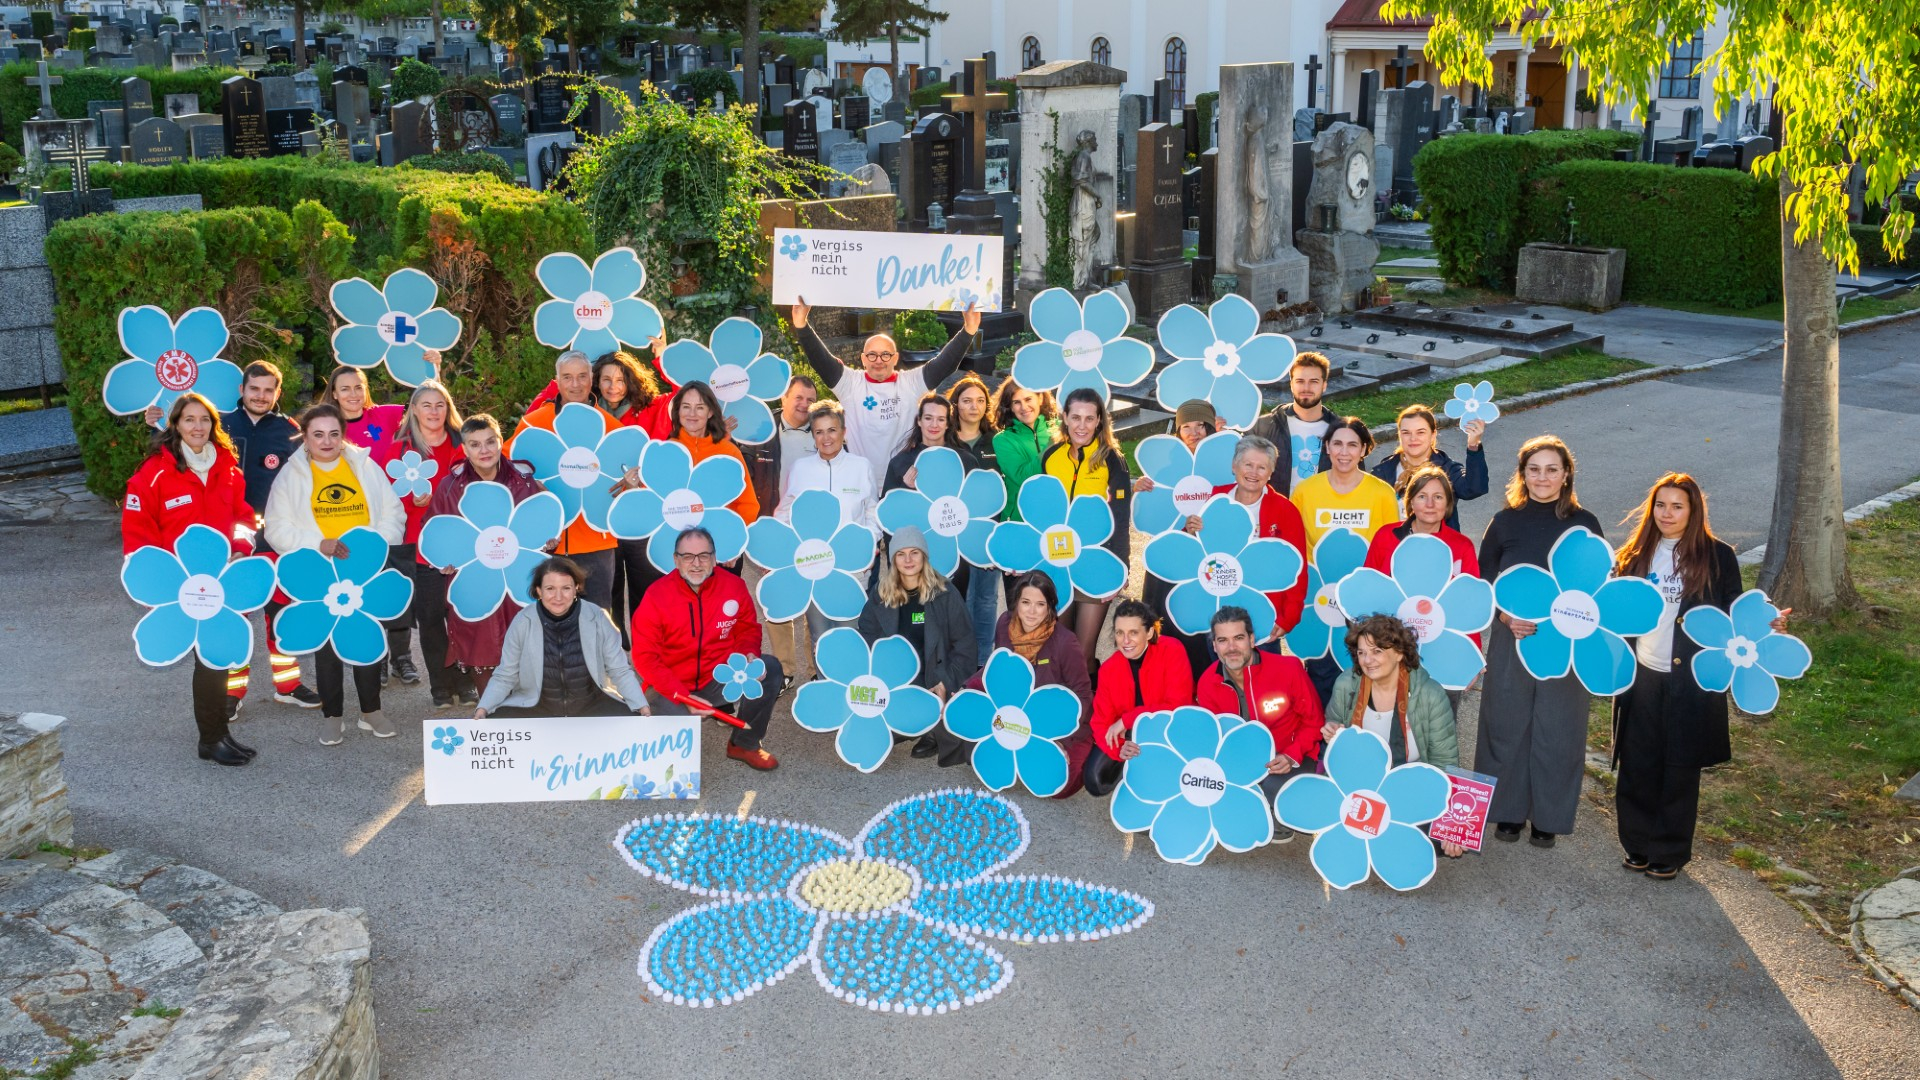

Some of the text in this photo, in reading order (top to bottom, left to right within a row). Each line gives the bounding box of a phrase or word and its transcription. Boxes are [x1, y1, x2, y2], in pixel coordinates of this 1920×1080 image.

[811, 239, 863, 253] Vergiss
[812, 253, 842, 264] mein
[811, 264, 848, 276] nicht
[876, 243, 983, 299] Danke!
[576, 304, 602, 317] cbm
[1332, 512, 1364, 520] LICHT
[1217, 579, 1238, 587] NETZ
[1662, 585, 1681, 594] mei
[470, 729, 532, 744] Vergiss
[471, 745, 507, 756] mein
[471, 757, 515, 770] nicht
[530, 727, 694, 791] In Erinnerung
[1181, 773, 1225, 791] Caritas
